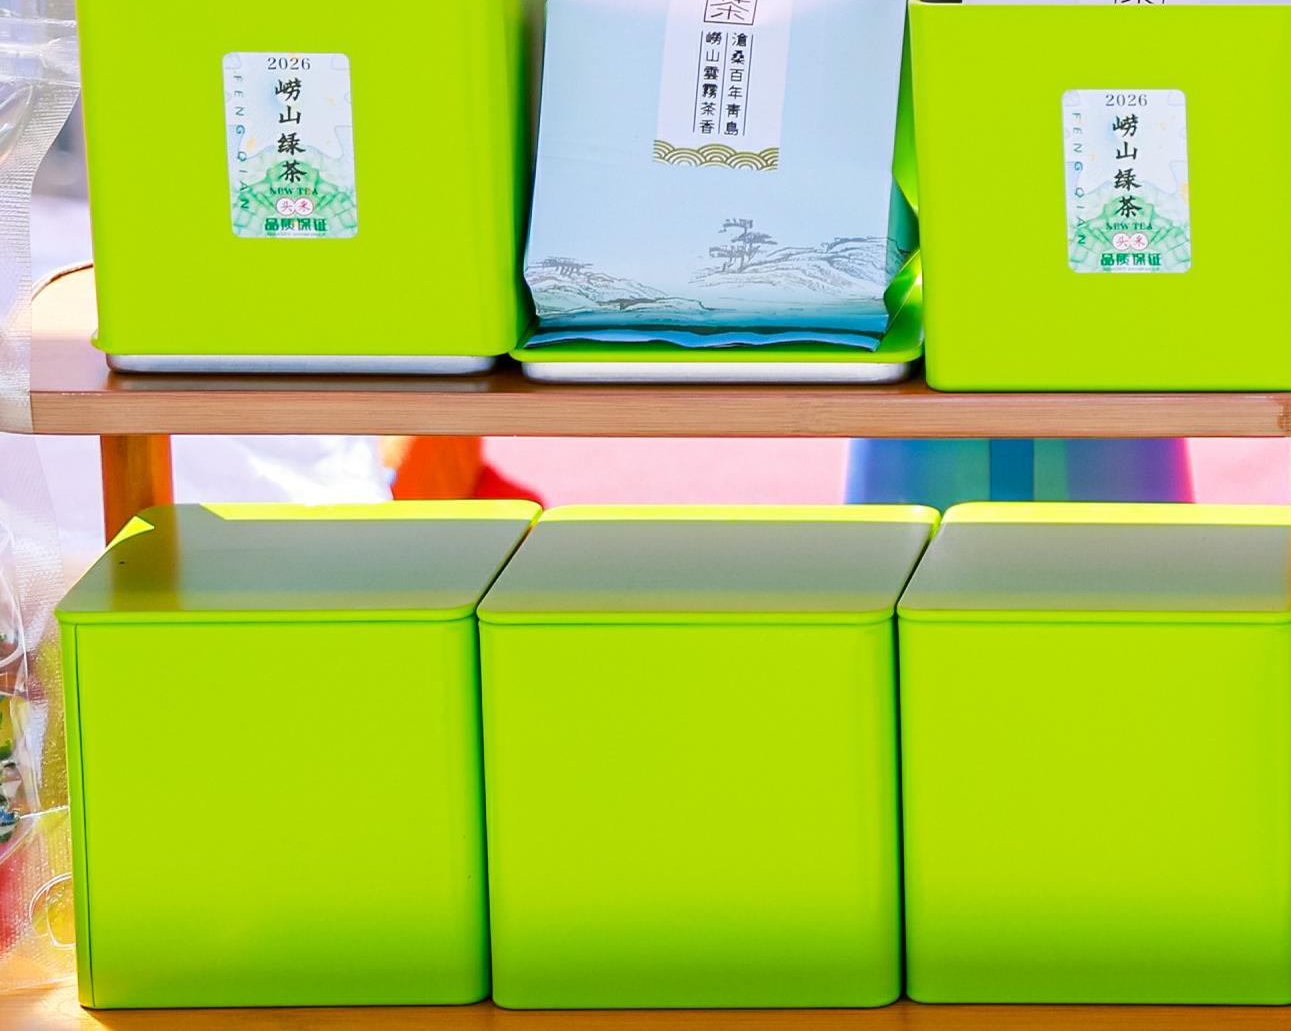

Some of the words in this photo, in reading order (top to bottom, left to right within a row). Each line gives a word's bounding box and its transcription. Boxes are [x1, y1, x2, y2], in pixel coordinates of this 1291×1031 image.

[267, 57, 311, 70] 2026
[232, 74, 246, 135] FENG
[1105, 94, 1148, 107] 2026
[274, 77, 306, 183] 崂山绿茶
[1072, 112, 1084, 171] FENG
[236, 151, 250, 210] QIAN
[1112, 113, 1142, 218] 崂山绿茶
[264, 218, 328, 231] 品质保证
[1073, 187, 1087, 245] QIAN
[1100, 253, 1161, 266] 品质保证
